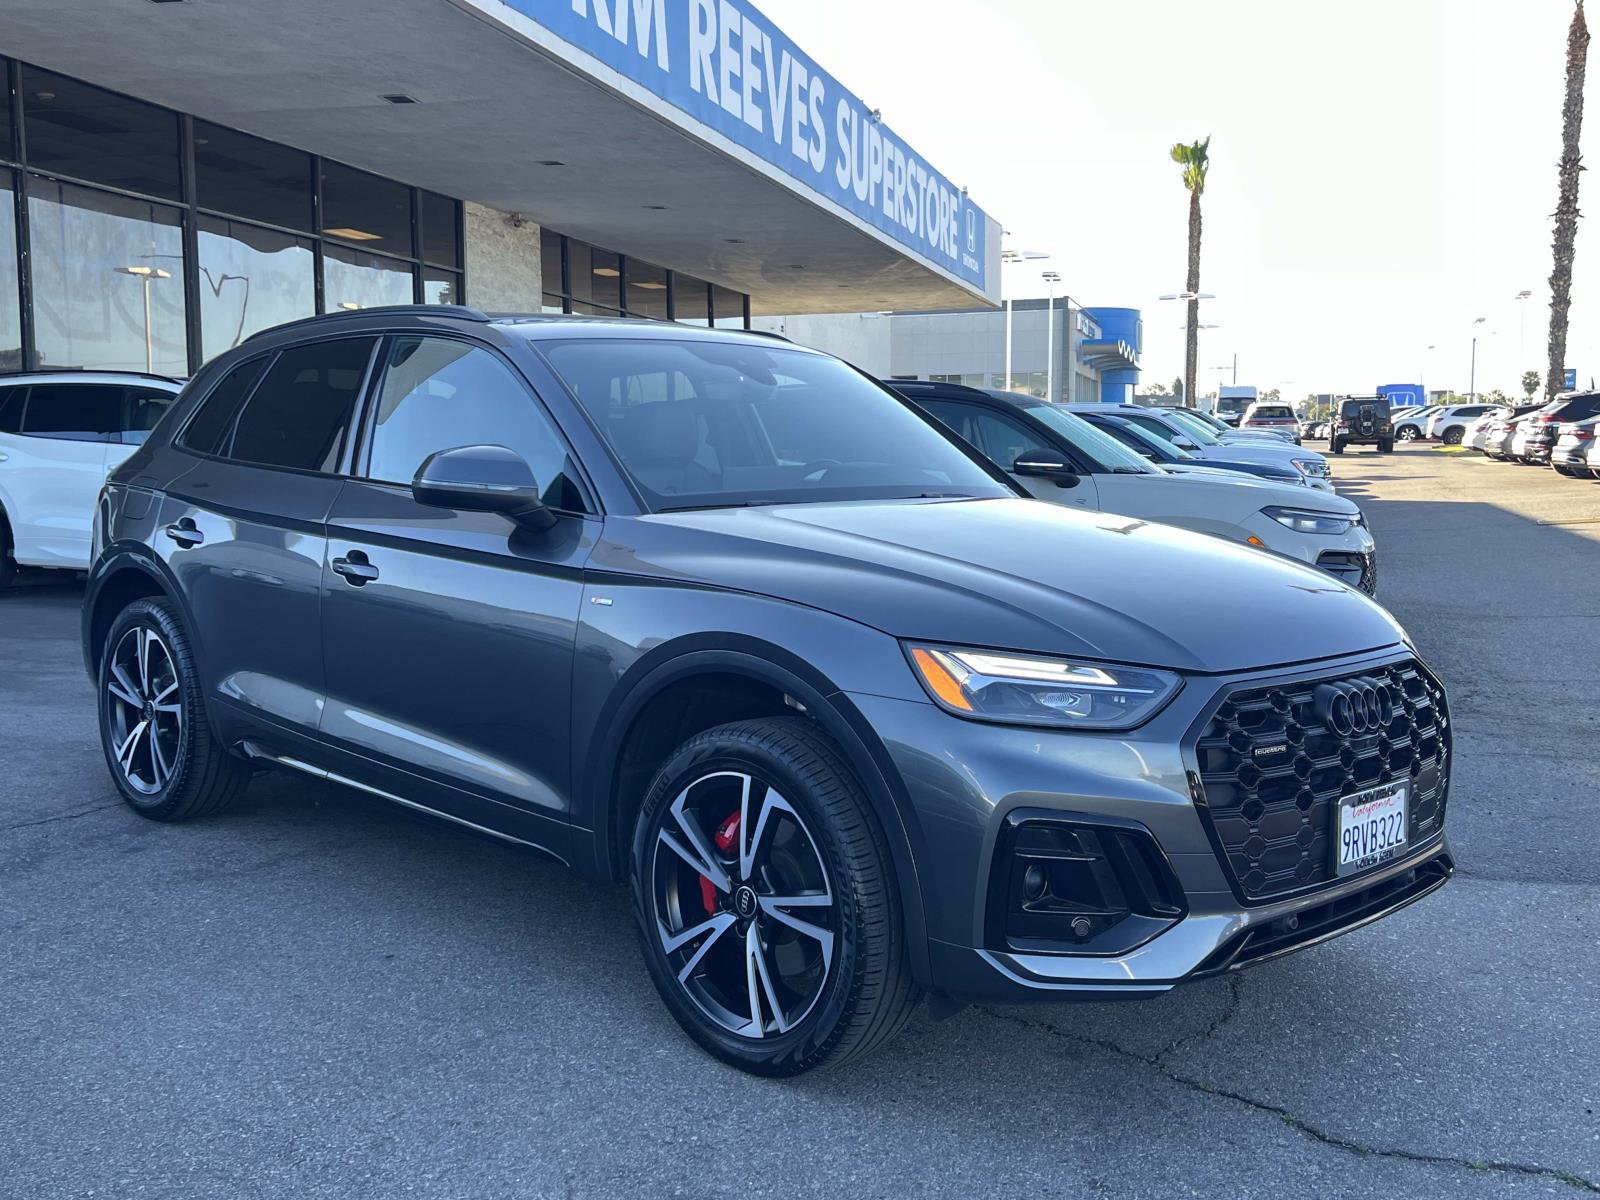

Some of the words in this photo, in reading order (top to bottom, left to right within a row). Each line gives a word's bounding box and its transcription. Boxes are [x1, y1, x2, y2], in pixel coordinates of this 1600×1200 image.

[688, 0, 826, 173] REEVES
[835, 98, 958, 260] SUPERSTORE
[1352, 797, 1394, 819] California
[1343, 810, 1403, 862] 9RVB322
